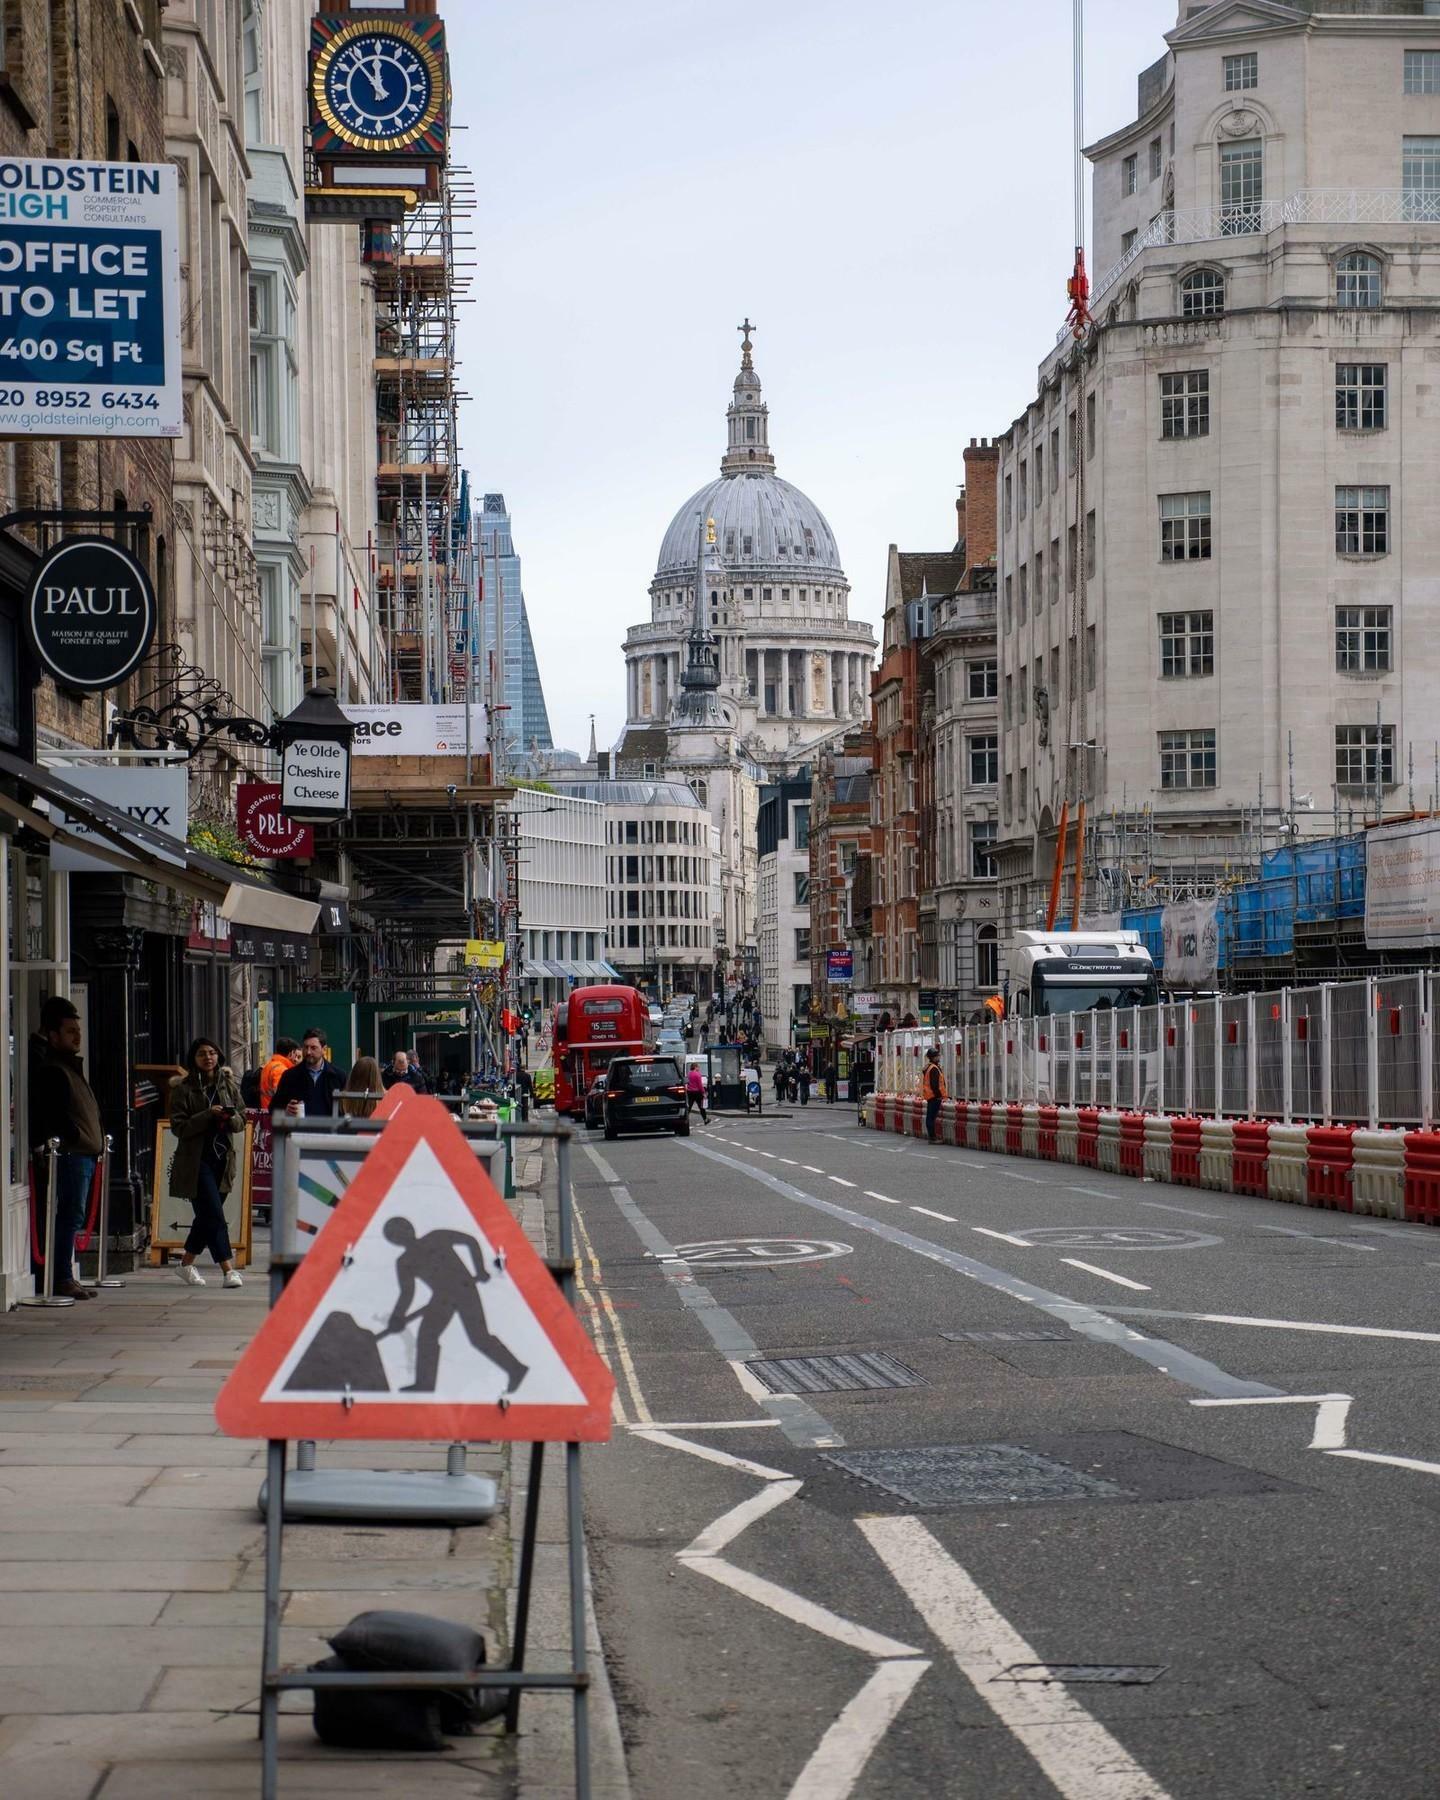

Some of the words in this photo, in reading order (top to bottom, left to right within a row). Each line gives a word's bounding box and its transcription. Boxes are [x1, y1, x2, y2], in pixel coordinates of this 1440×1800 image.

[84, 195, 142, 205] COMMERCIAL
[84, 204, 127, 213] PROPERTY
[84, 213, 147, 223] CONSULTANTS
[0, 240, 148, 276] OFFICE
[0, 286, 54, 317] TO
[69, 287, 146, 320] LET
[66, 340, 104, 367] Sq
[112, 341, 143, 363] Ft
[35, 390, 91, 408] 8952
[101, 392, 160, 410] 6434
[43, 586, 140, 615] PAUL
[52, 630, 82, 638] MAISON
[84, 630, 94, 638] DE
[355, 721, 402, 736] ace
[294, 744, 308, 756] Ye
[310, 745, 340, 758] Olde
[287, 764, 341, 778] Cheshire
[294, 786, 339, 799] Cheese
[247, 793, 276, 815] ORGANIC
[246, 829, 271, 853] FRESHLY
[272, 843, 294, 855] MADE
[292, 828, 305, 847] FOOD
